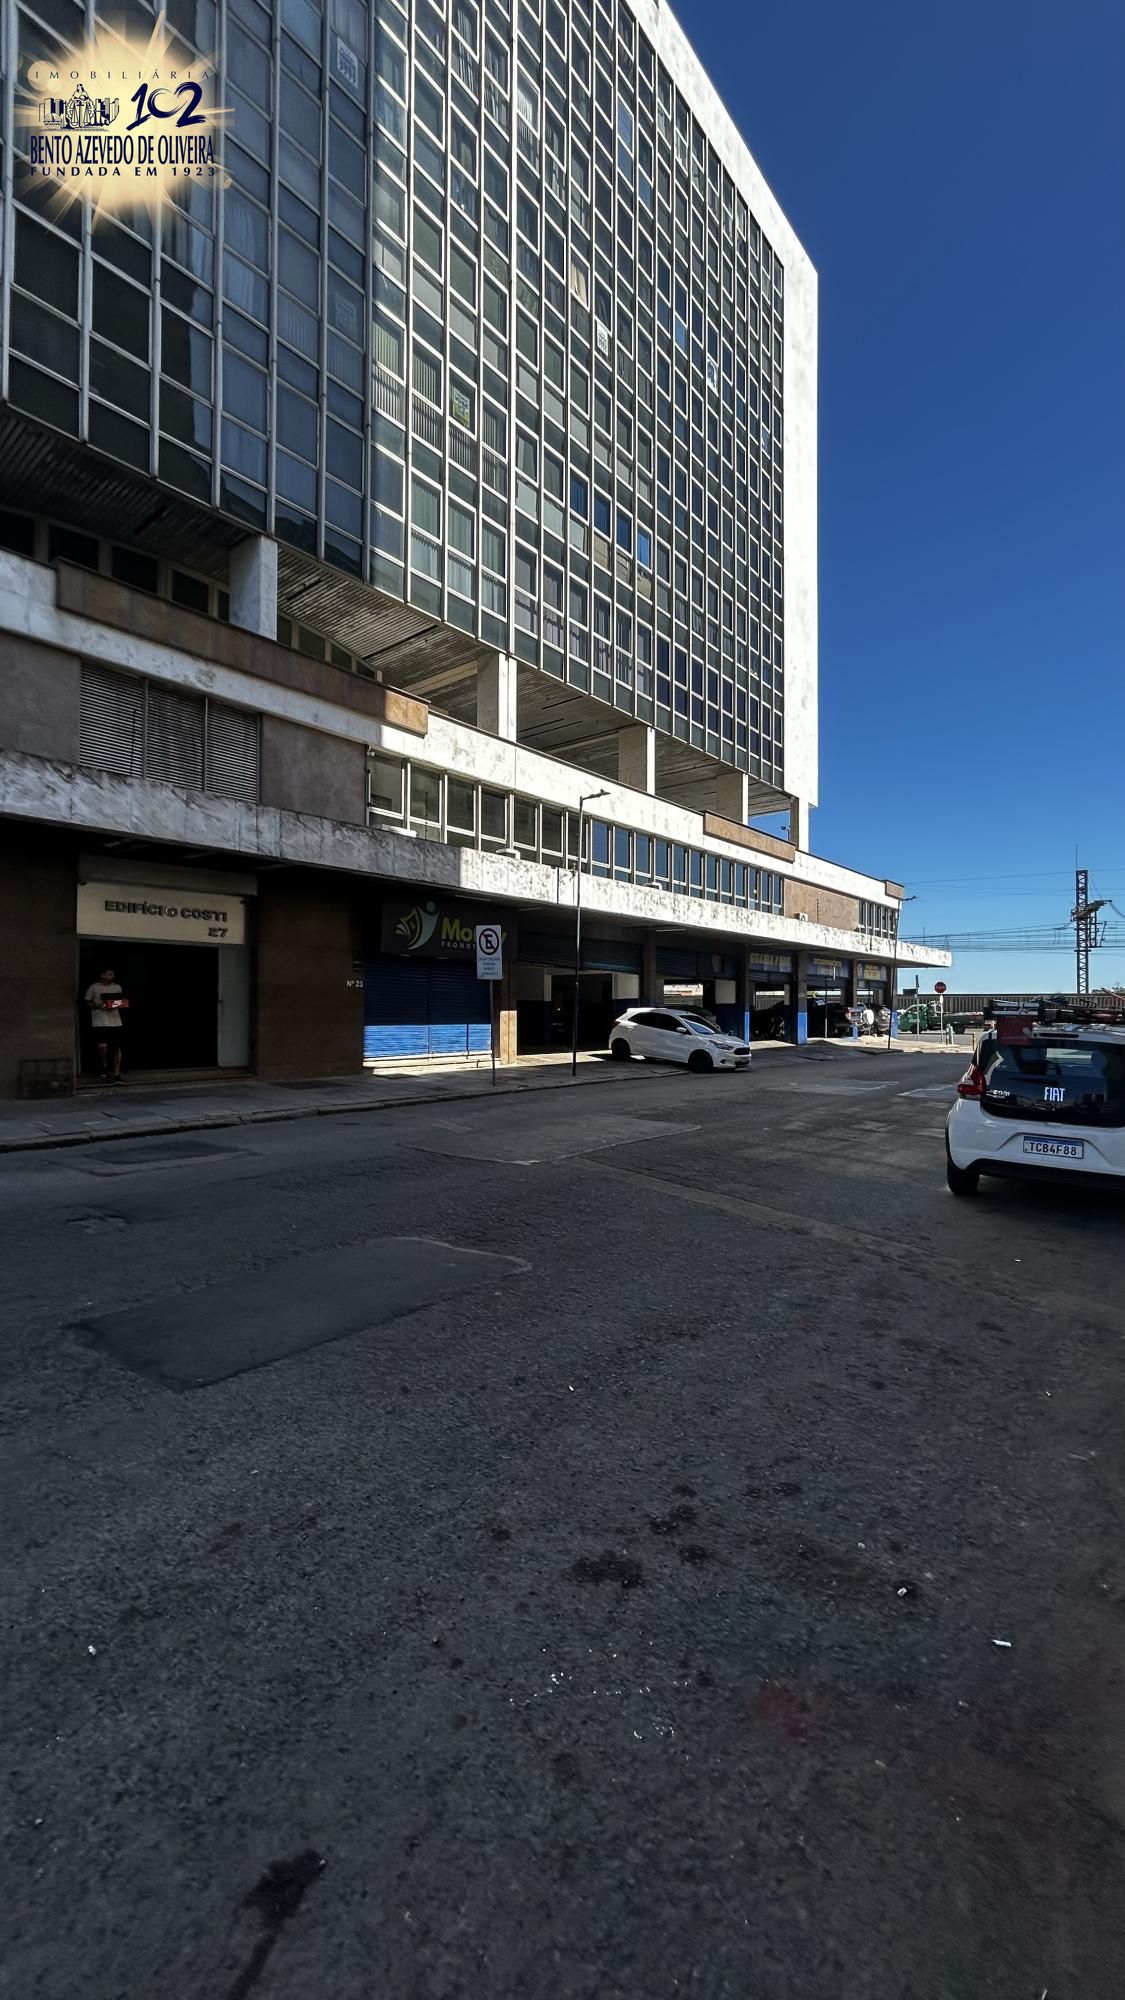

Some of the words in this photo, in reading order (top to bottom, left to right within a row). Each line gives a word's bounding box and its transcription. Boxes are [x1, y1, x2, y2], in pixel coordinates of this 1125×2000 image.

[180, 907, 228, 922] COSTI
[1044, 1086, 1066, 1102] FIAT
[1030, 1142, 1077, 1156] TCB4F88
